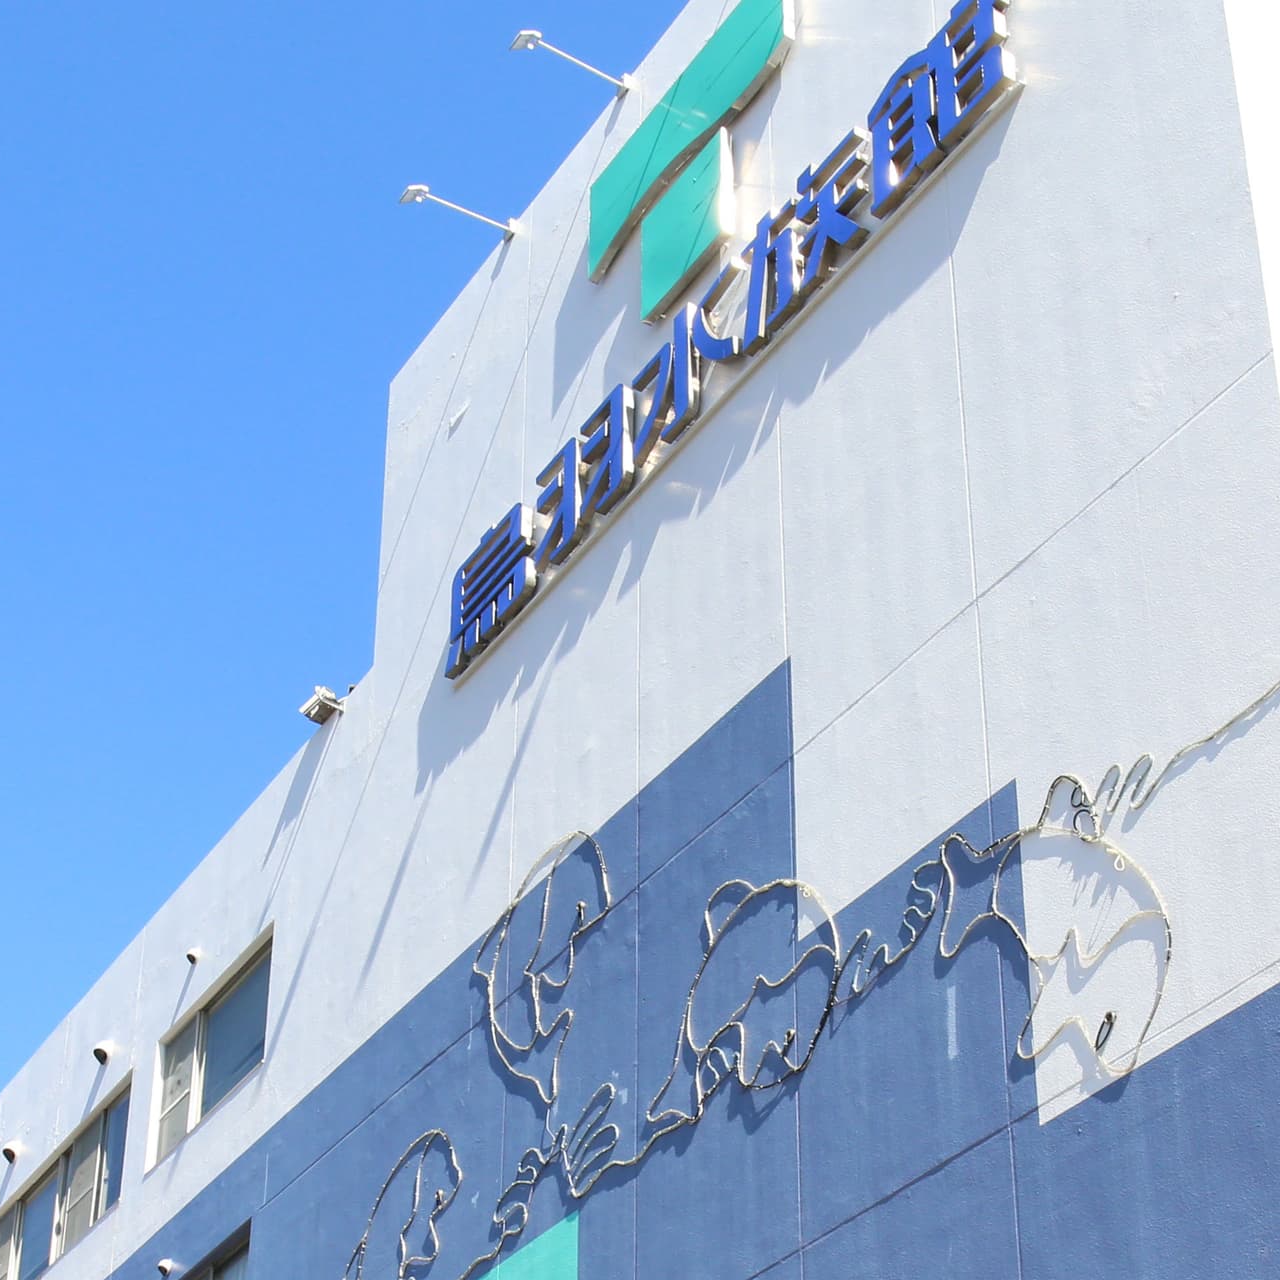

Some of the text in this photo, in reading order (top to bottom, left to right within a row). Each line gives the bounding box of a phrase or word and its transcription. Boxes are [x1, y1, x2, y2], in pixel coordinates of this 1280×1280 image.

[445, 0, 1018, 680] 鳥羽水族館
